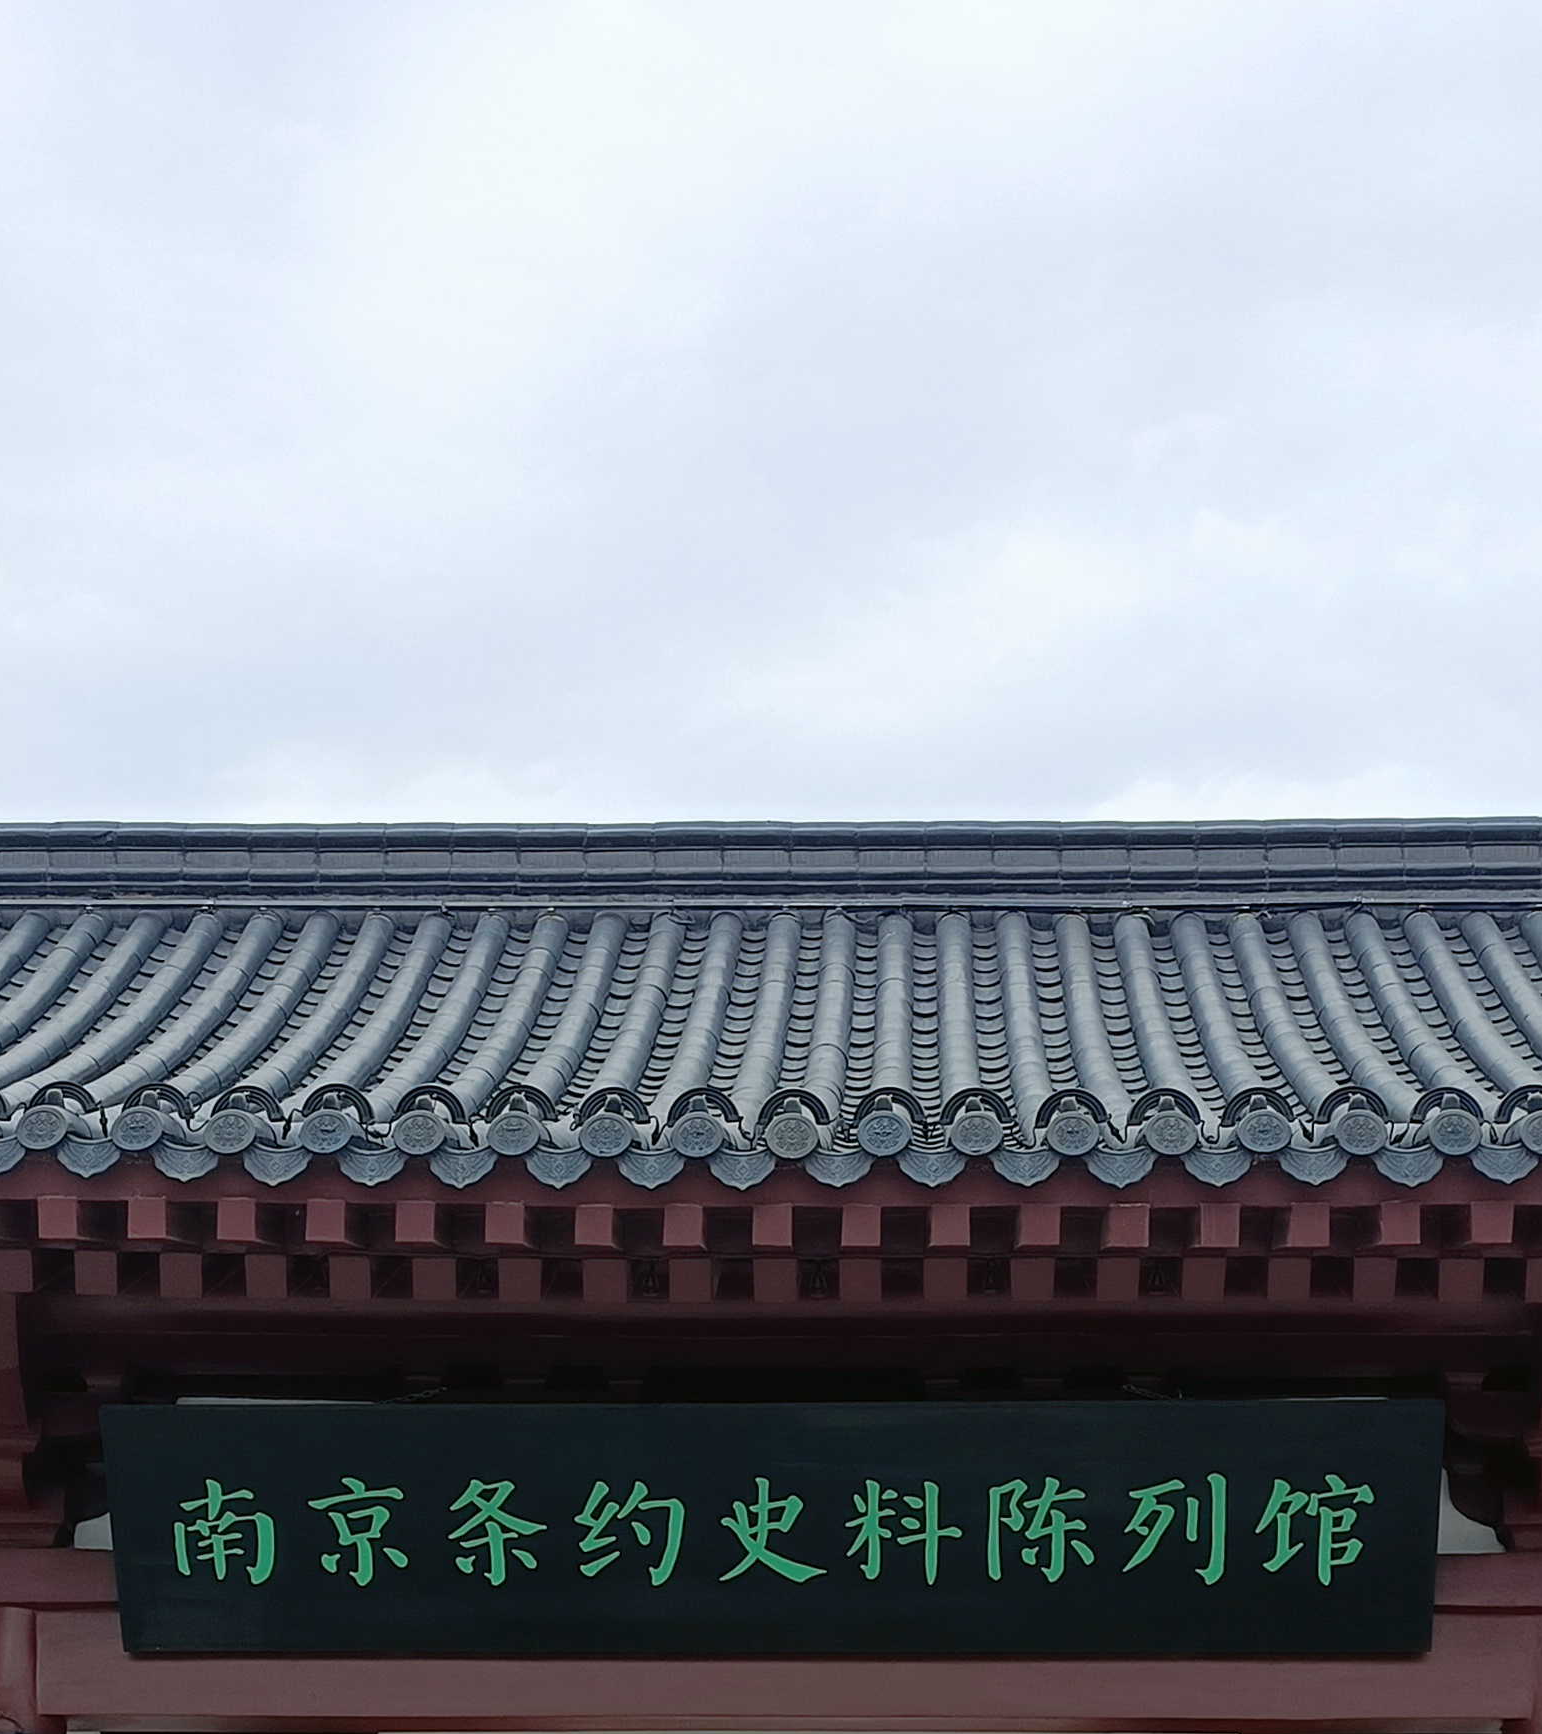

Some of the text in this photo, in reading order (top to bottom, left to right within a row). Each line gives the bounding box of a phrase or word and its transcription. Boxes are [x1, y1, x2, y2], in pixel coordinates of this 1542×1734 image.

[172, 1472, 1379, 1588] 南京条约史料陈列馆
